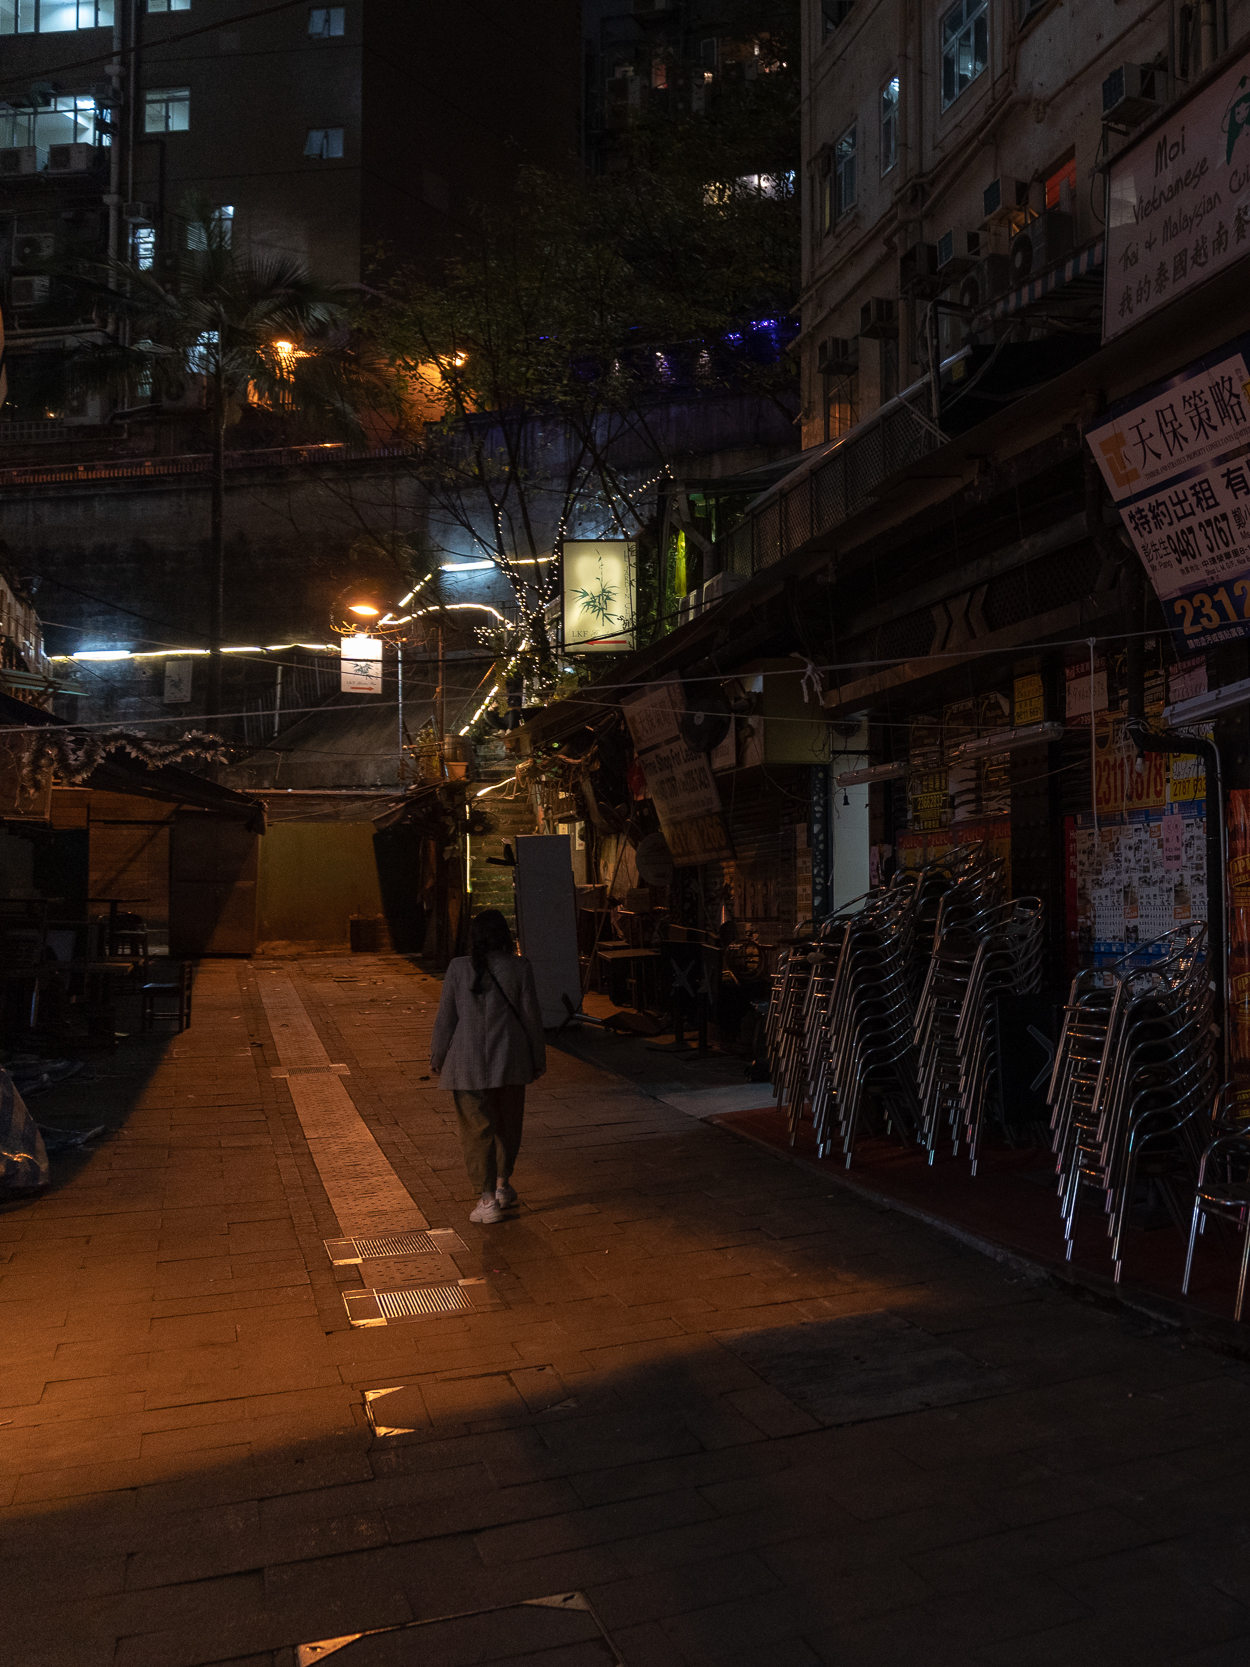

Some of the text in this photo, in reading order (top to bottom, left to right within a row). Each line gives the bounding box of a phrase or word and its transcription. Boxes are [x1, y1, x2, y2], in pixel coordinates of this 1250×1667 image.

[1155, 126, 1187, 178] Moi
[1132, 156, 1209, 226] Vietnamese
[1119, 241, 1139, 273] Thai
[1162, 191, 1222, 247] Malaysian
[1126, 373, 1248, 471] 天保策略
[1127, 477, 1221, 538] 特約出租
[1159, 560, 1174, 570] Pang
[1167, 526, 1203, 565] 9487
[1198, 512, 1237, 554] 3767
